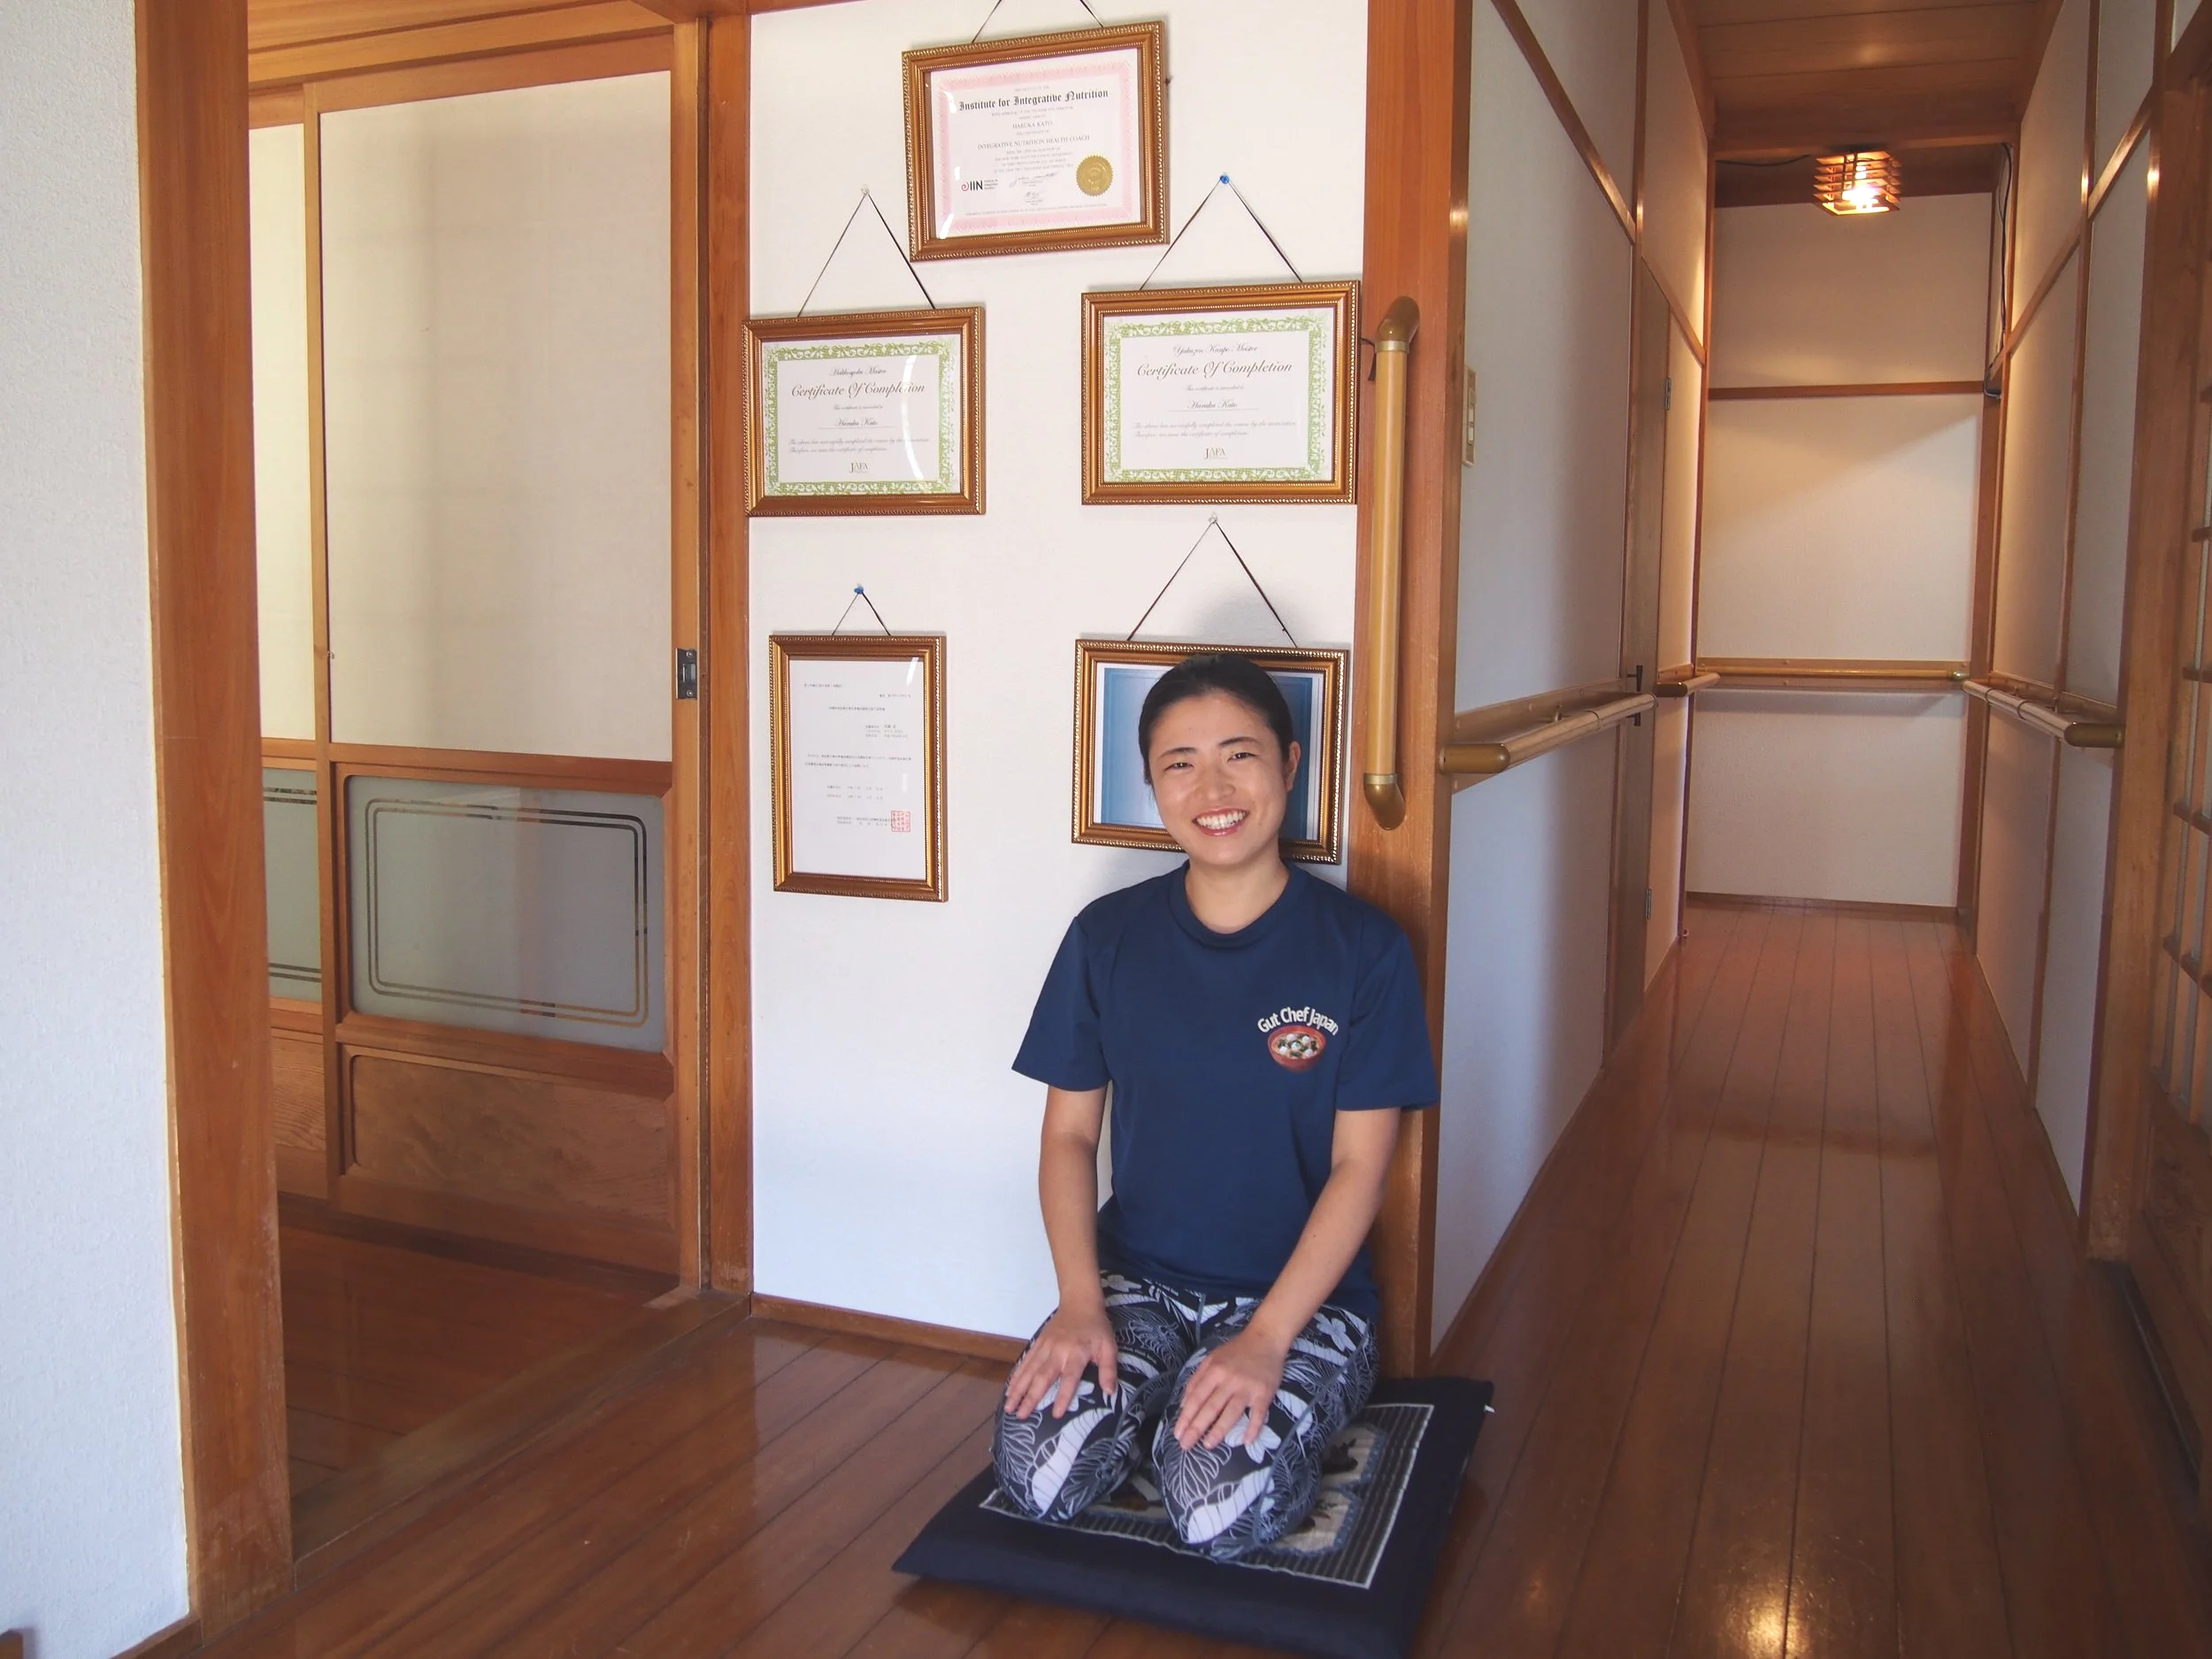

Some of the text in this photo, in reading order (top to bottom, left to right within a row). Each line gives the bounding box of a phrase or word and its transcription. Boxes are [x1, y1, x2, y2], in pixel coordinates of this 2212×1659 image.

[959, 100, 996, 111] Institute
[998, 98, 1010, 107] for
[1013, 94, 1062, 106] Integrative
[1064, 89, 1109, 102] Nutrition
[970, 180, 983, 191] IIN
[1137, 359, 1293, 380] Certificate Of Completion
[792, 383, 845, 400] Certificate
[848, 380, 866, 399] Of
[1257, 1006, 1339, 1036] Gut Chef Japan
